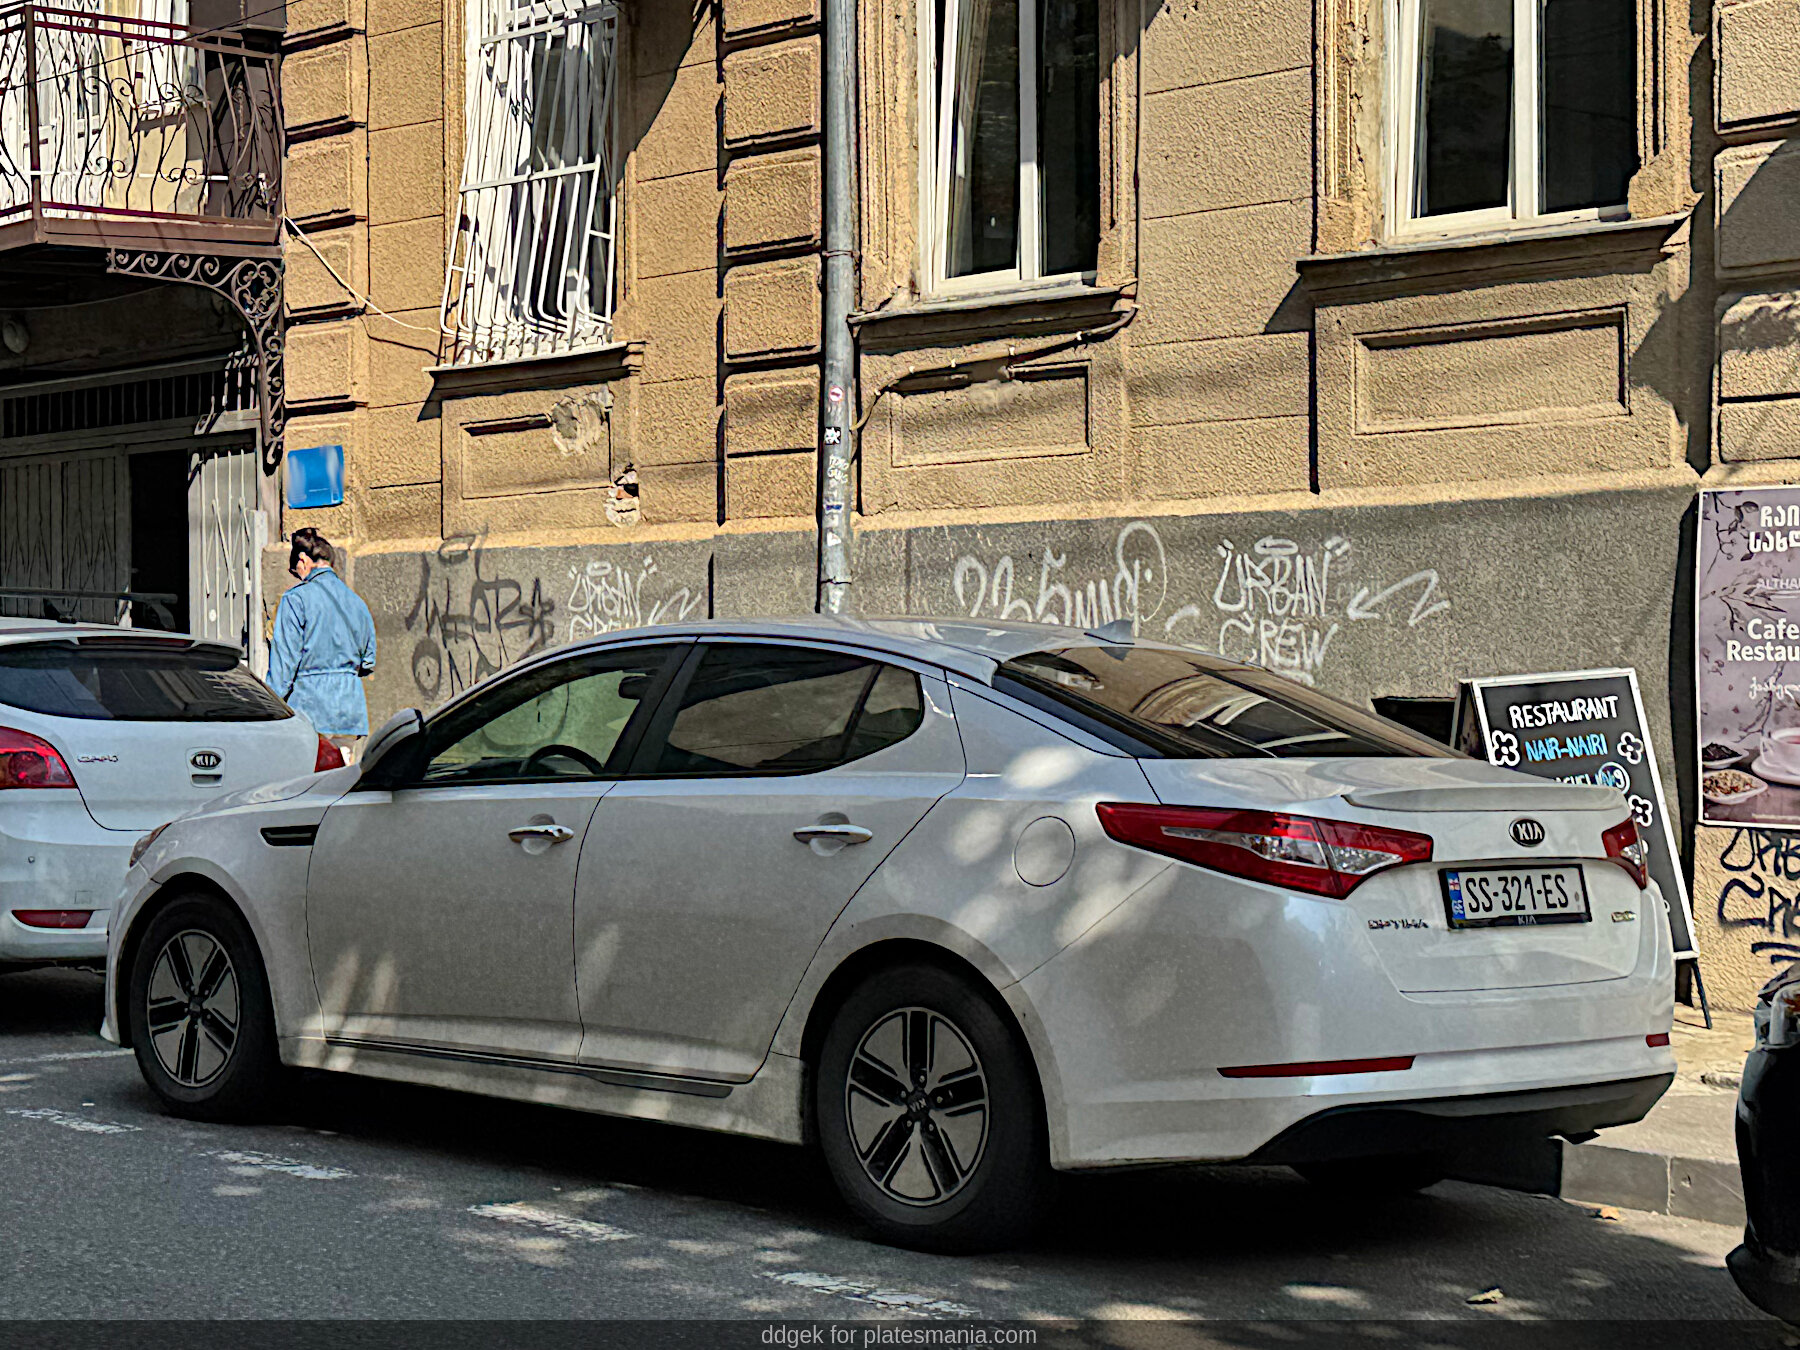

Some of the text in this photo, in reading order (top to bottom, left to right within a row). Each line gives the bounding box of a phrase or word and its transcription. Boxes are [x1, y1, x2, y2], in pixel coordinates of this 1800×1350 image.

[1213, 548, 1334, 617] URBAN
[1756, 577, 1800, 590] ALTHA
[1747, 617, 1800, 640] Cafe
[1509, 695, 1619, 729] RESTAURANT
[195, 755, 218, 766] KIA
[1517, 822, 1545, 841] KIA
[1465, 874, 1569, 913] SS-321-ES
[1517, 914, 1537, 925] KIA
